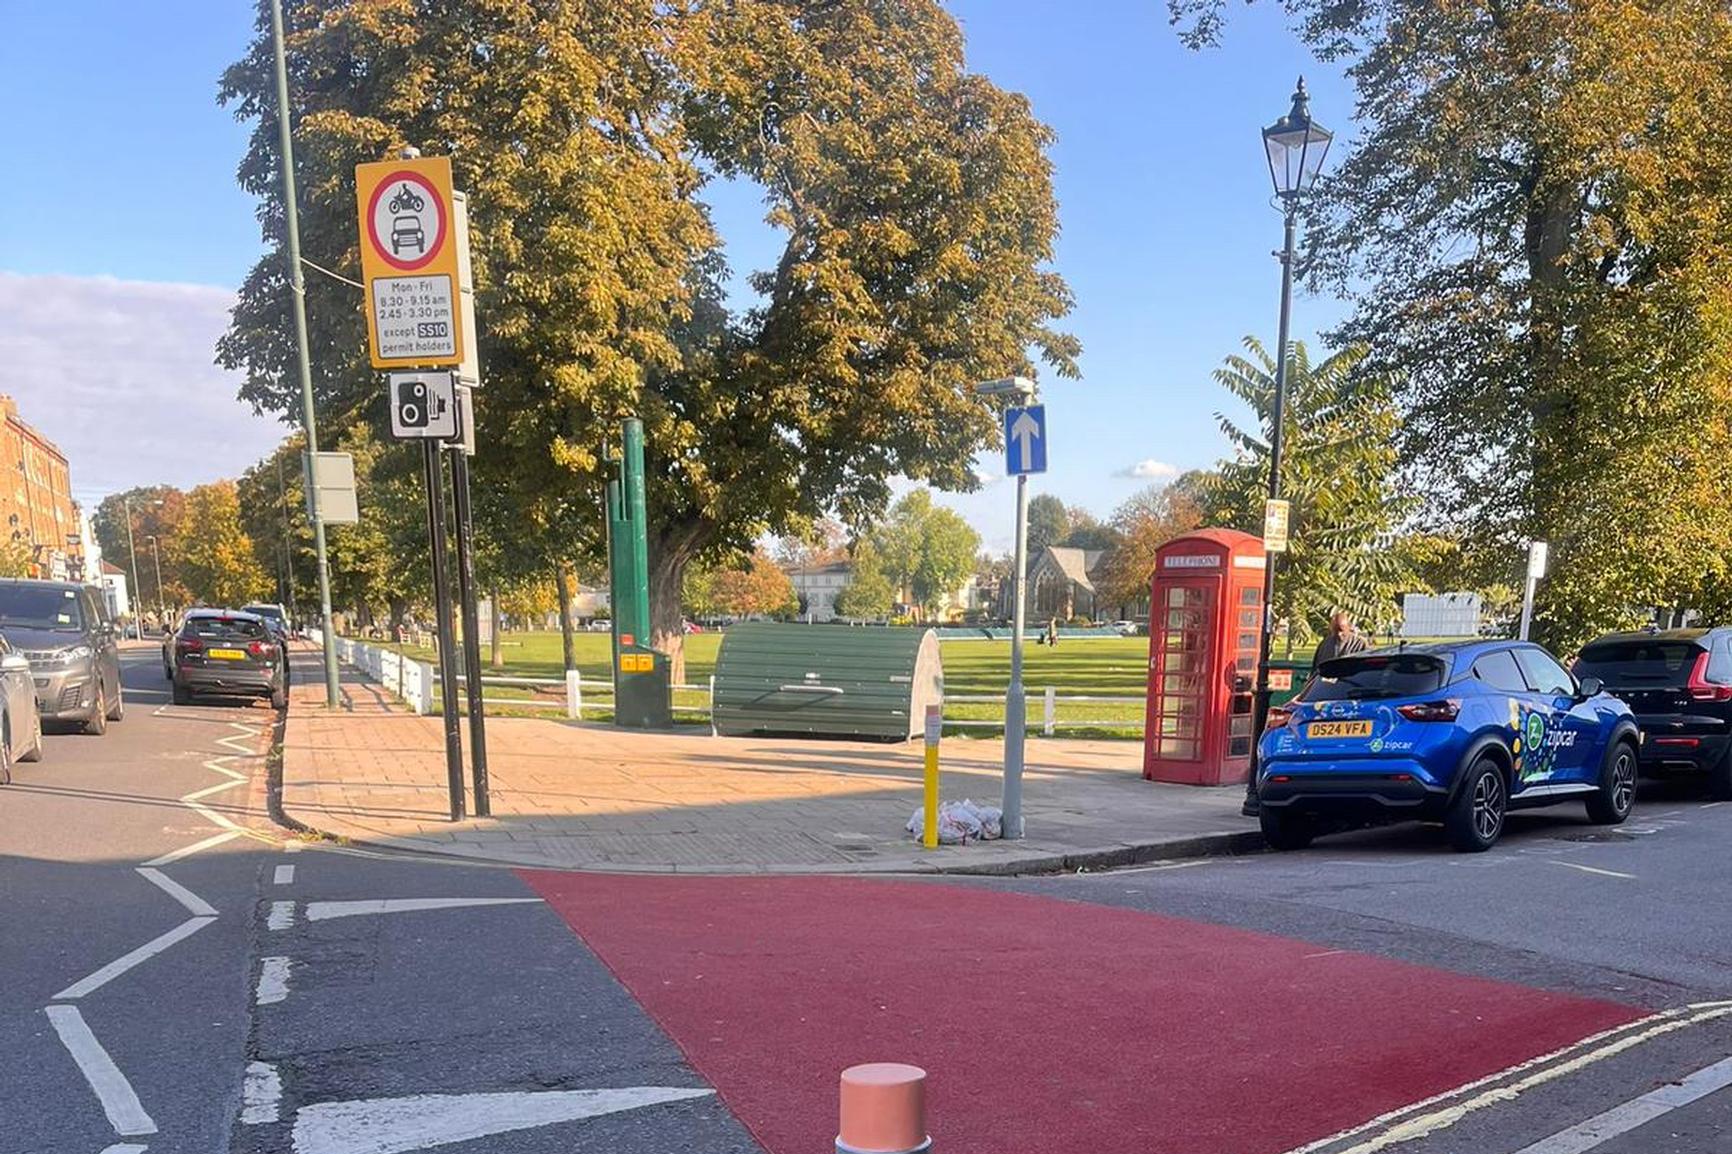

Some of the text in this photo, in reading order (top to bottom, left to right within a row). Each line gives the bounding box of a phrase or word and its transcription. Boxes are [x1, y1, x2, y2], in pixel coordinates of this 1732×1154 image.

[391, 282, 413, 292] Mon
[419, 281, 433, 291] Fri
[379, 308, 402, 319] 2.45
[409, 307, 432, 318] 3.30
[434, 309, 448, 318] pm
[384, 324, 447, 337] except SS10
[382, 341, 451, 353] permit holders
[1312, 722, 1367, 736] DS24 VFA
[1384, 739, 1413, 750] zipcar
[1548, 730, 1577, 751] zipcar
